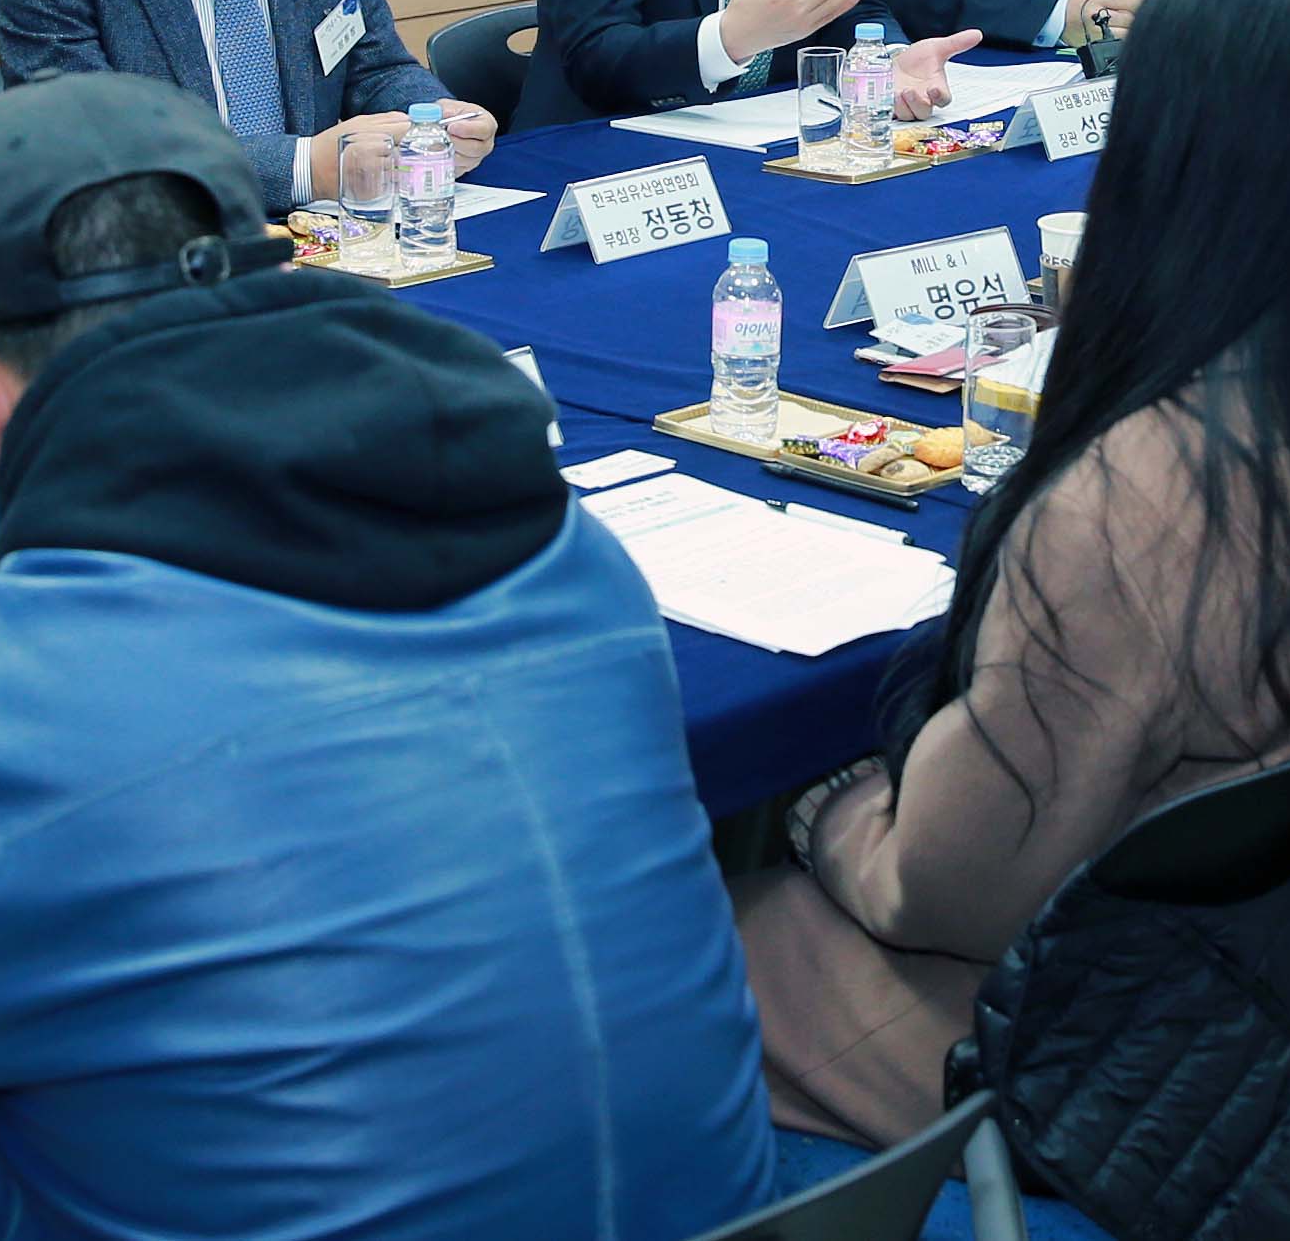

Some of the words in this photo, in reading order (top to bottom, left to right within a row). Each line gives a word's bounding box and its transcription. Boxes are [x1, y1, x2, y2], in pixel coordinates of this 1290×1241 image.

[1058, 131, 1079, 149] 장관
[591, 172, 699, 209] 한국섬유산업연합회
[603, 226, 641, 248] 부회장
[641, 197, 715, 241] 정동창
[910, 252, 942, 276] MILL
[945, 252, 958, 269] &
[925, 271, 1010, 321] 명유석
